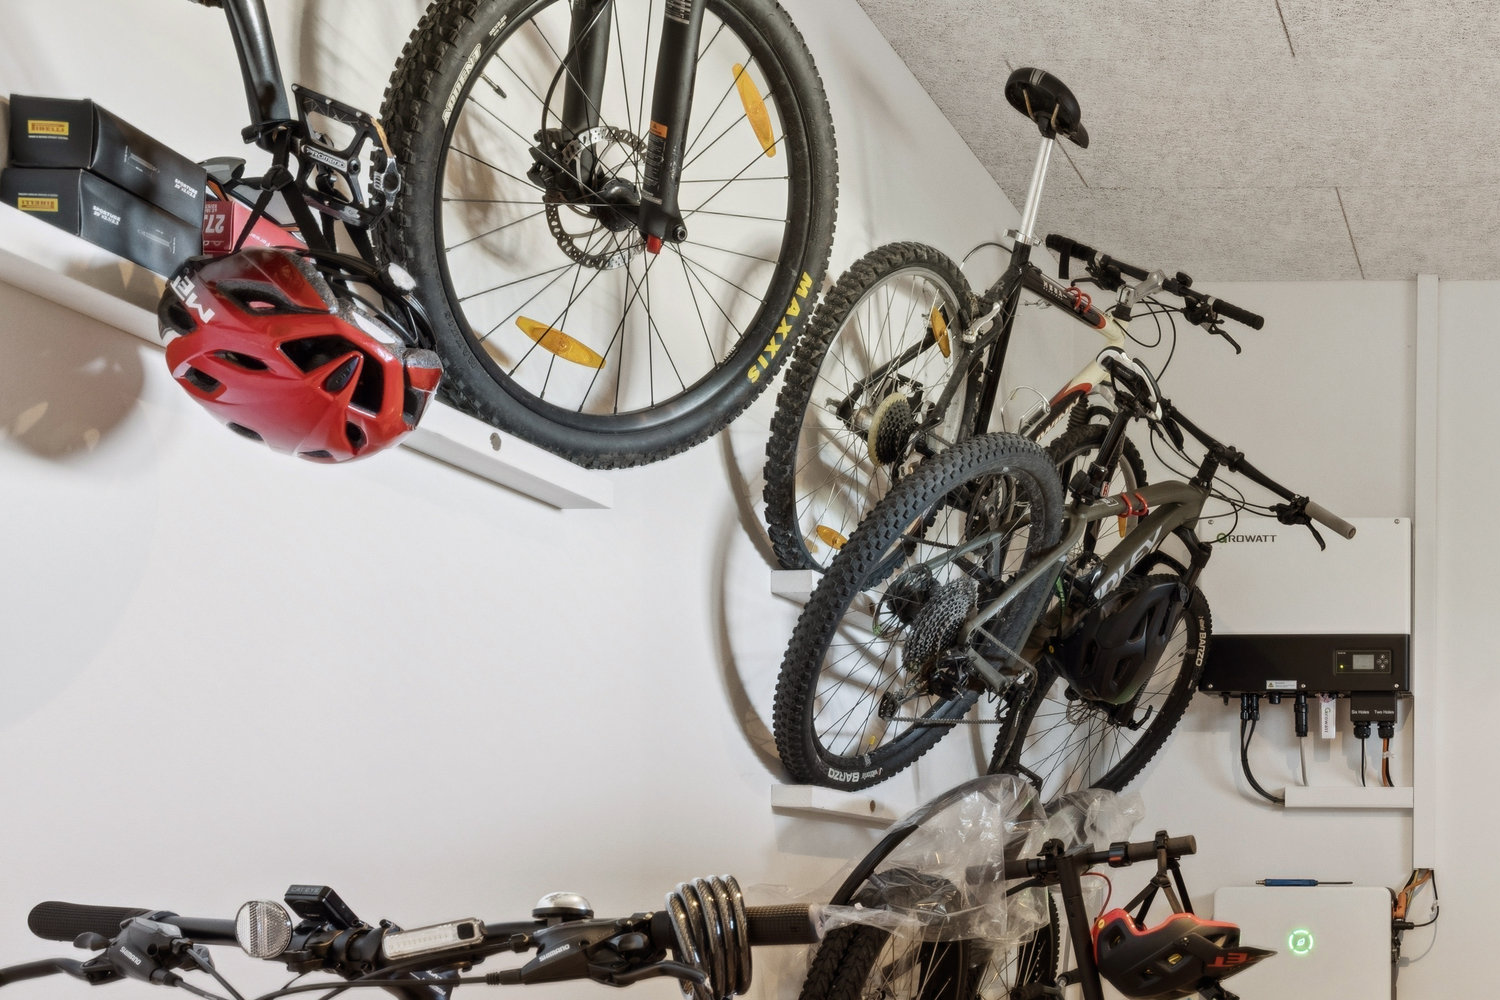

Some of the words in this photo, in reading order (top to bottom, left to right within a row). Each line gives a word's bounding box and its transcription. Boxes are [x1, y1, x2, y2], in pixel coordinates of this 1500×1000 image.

[30, 122, 66, 133] PIRELLI
[169, 274, 216, 324] MET
[747, 271, 813, 384] MAXXIS
[1216, 532, 1277, 544] GROWATT
[1093, 524, 1163, 600] IDLEY
[1195, 632, 1207, 667] BARZO
[827, 767, 860, 782] BARZO
[120, 945, 142, 966] SHIMANO
[538, 943, 571, 963] SHIMANO
[1207, 952, 1254, 967] ET
